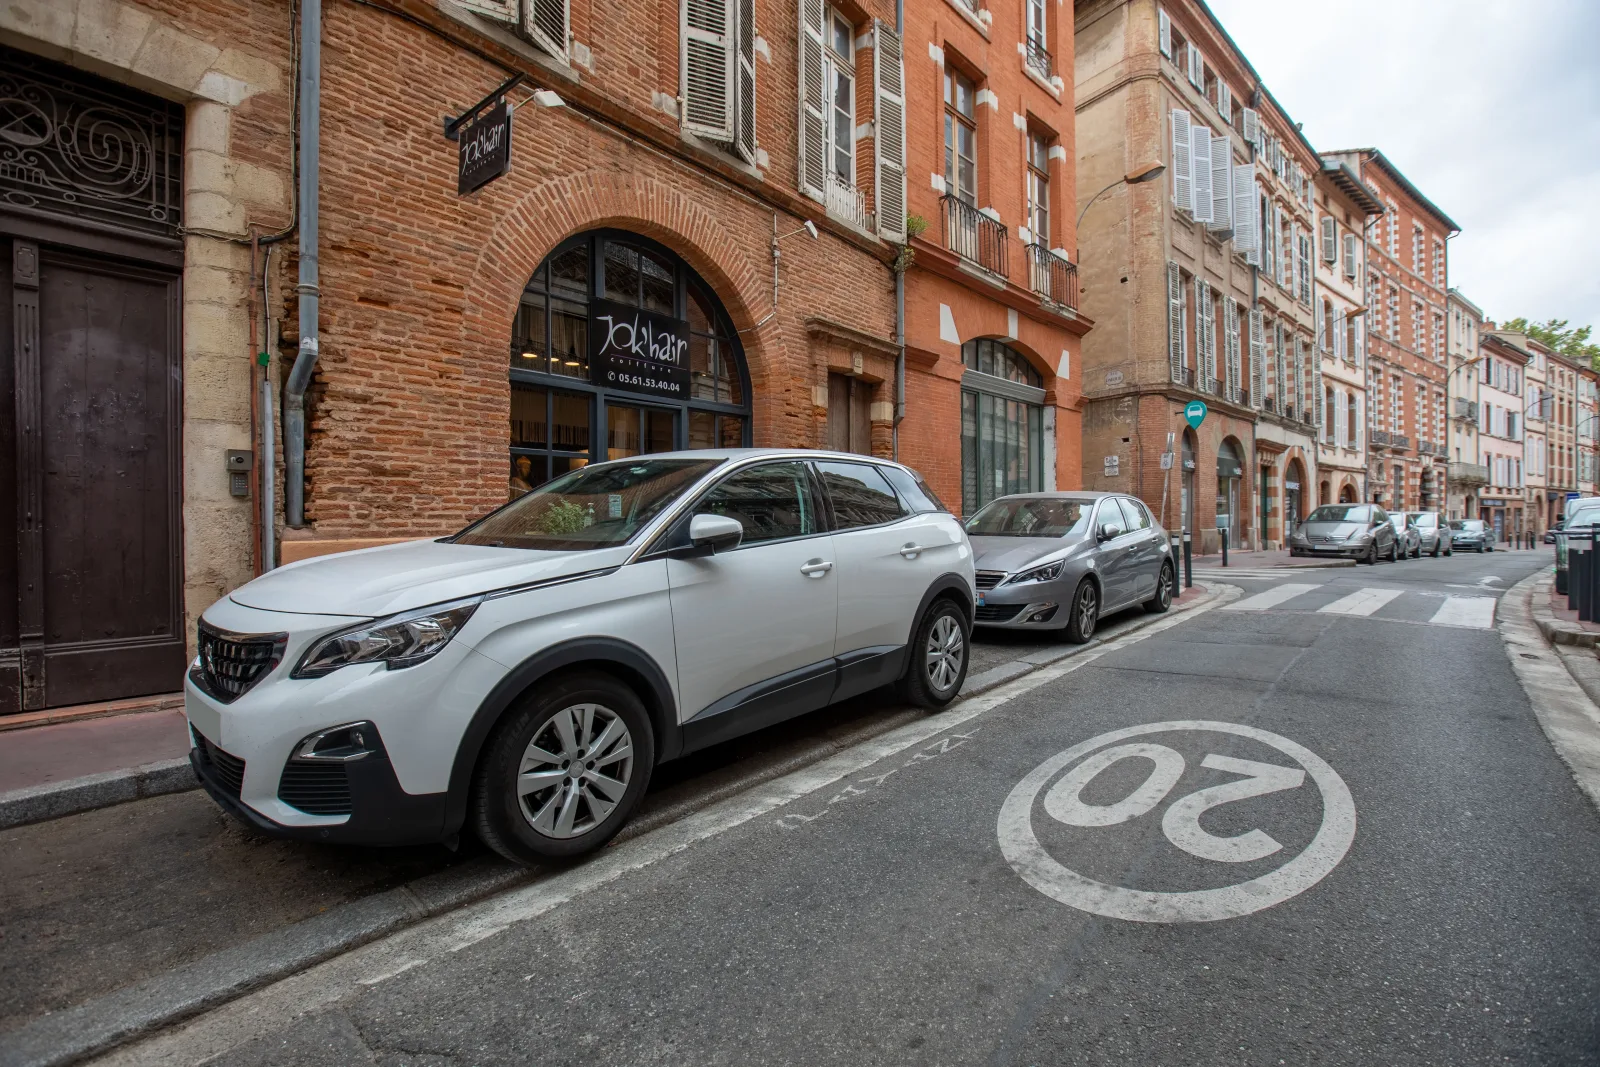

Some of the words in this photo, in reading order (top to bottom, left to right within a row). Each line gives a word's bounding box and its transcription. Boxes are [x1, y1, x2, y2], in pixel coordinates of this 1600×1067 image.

[610, 358, 671, 374] coiffure
[618, 373, 680, 392] 05.61.53.40.04
[1043, 743, 1306, 863] 20
